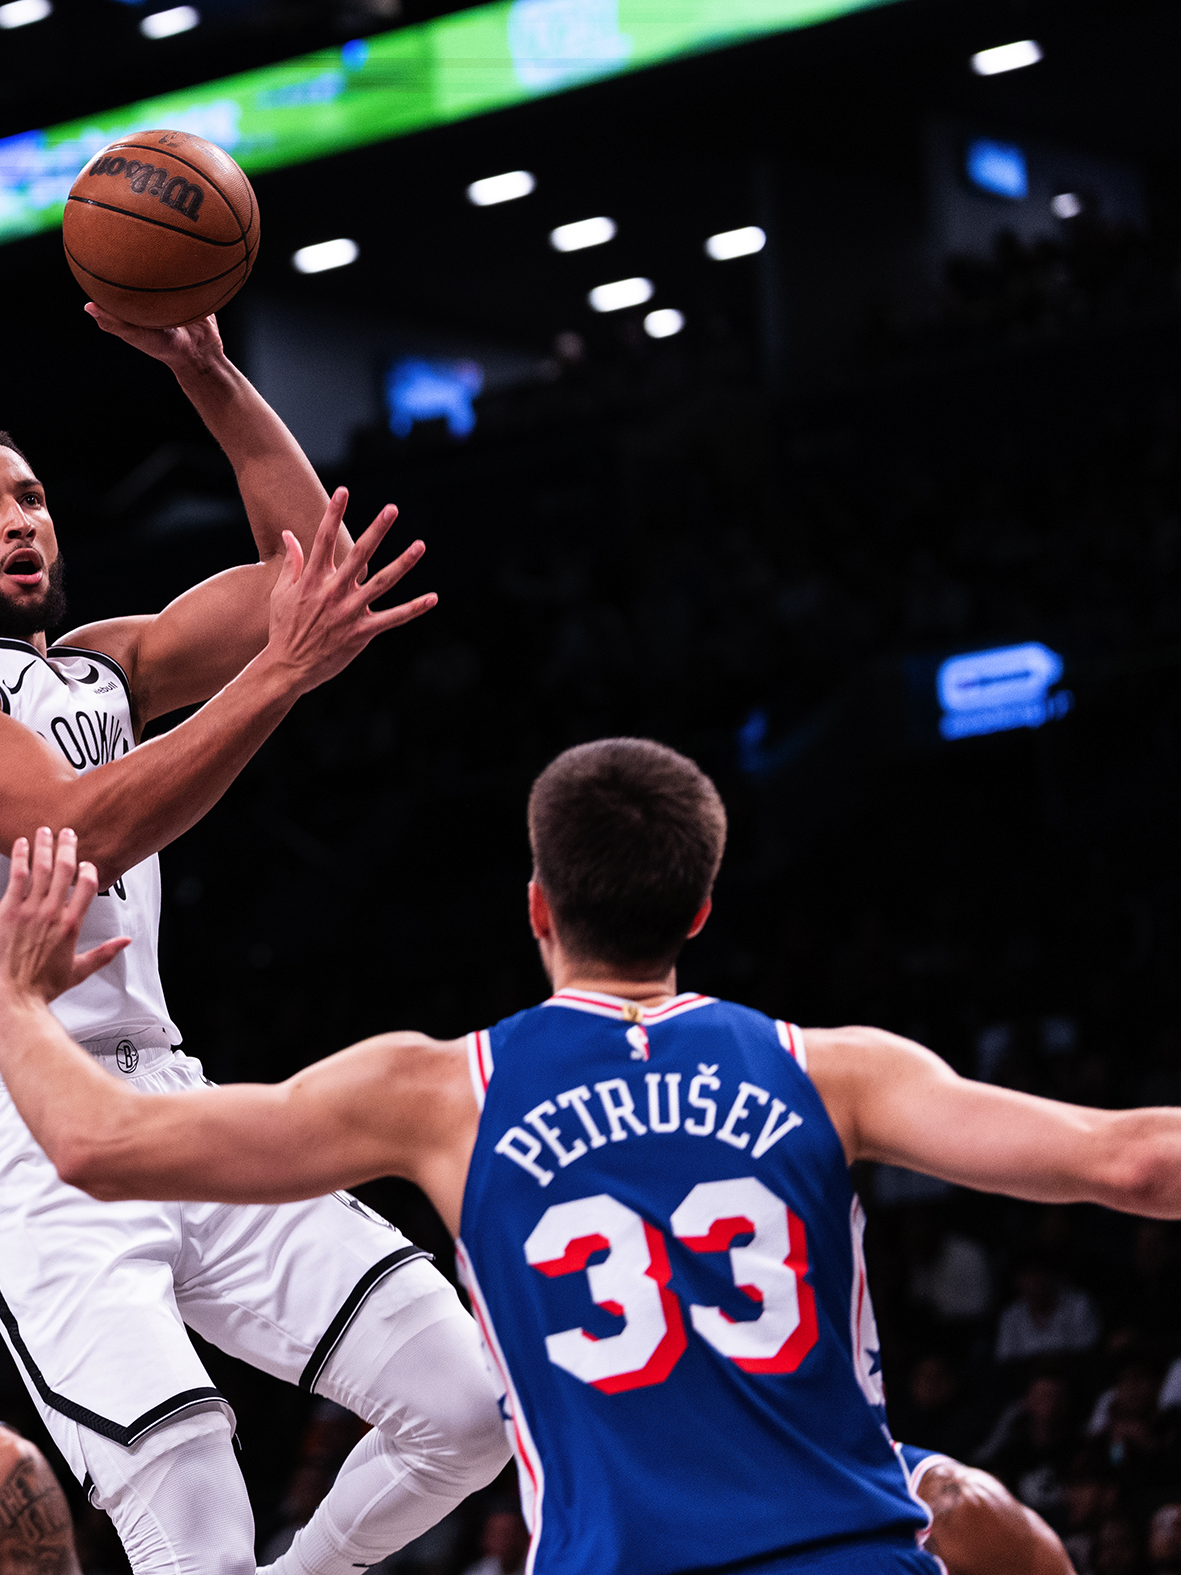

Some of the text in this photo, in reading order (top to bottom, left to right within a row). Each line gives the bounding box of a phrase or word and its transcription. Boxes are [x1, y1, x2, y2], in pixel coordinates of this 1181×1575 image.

[89, 156, 205, 223] Wilson
[494, 1063, 804, 1187] PETRUŠEV
[524, 1176, 819, 1395] 33
